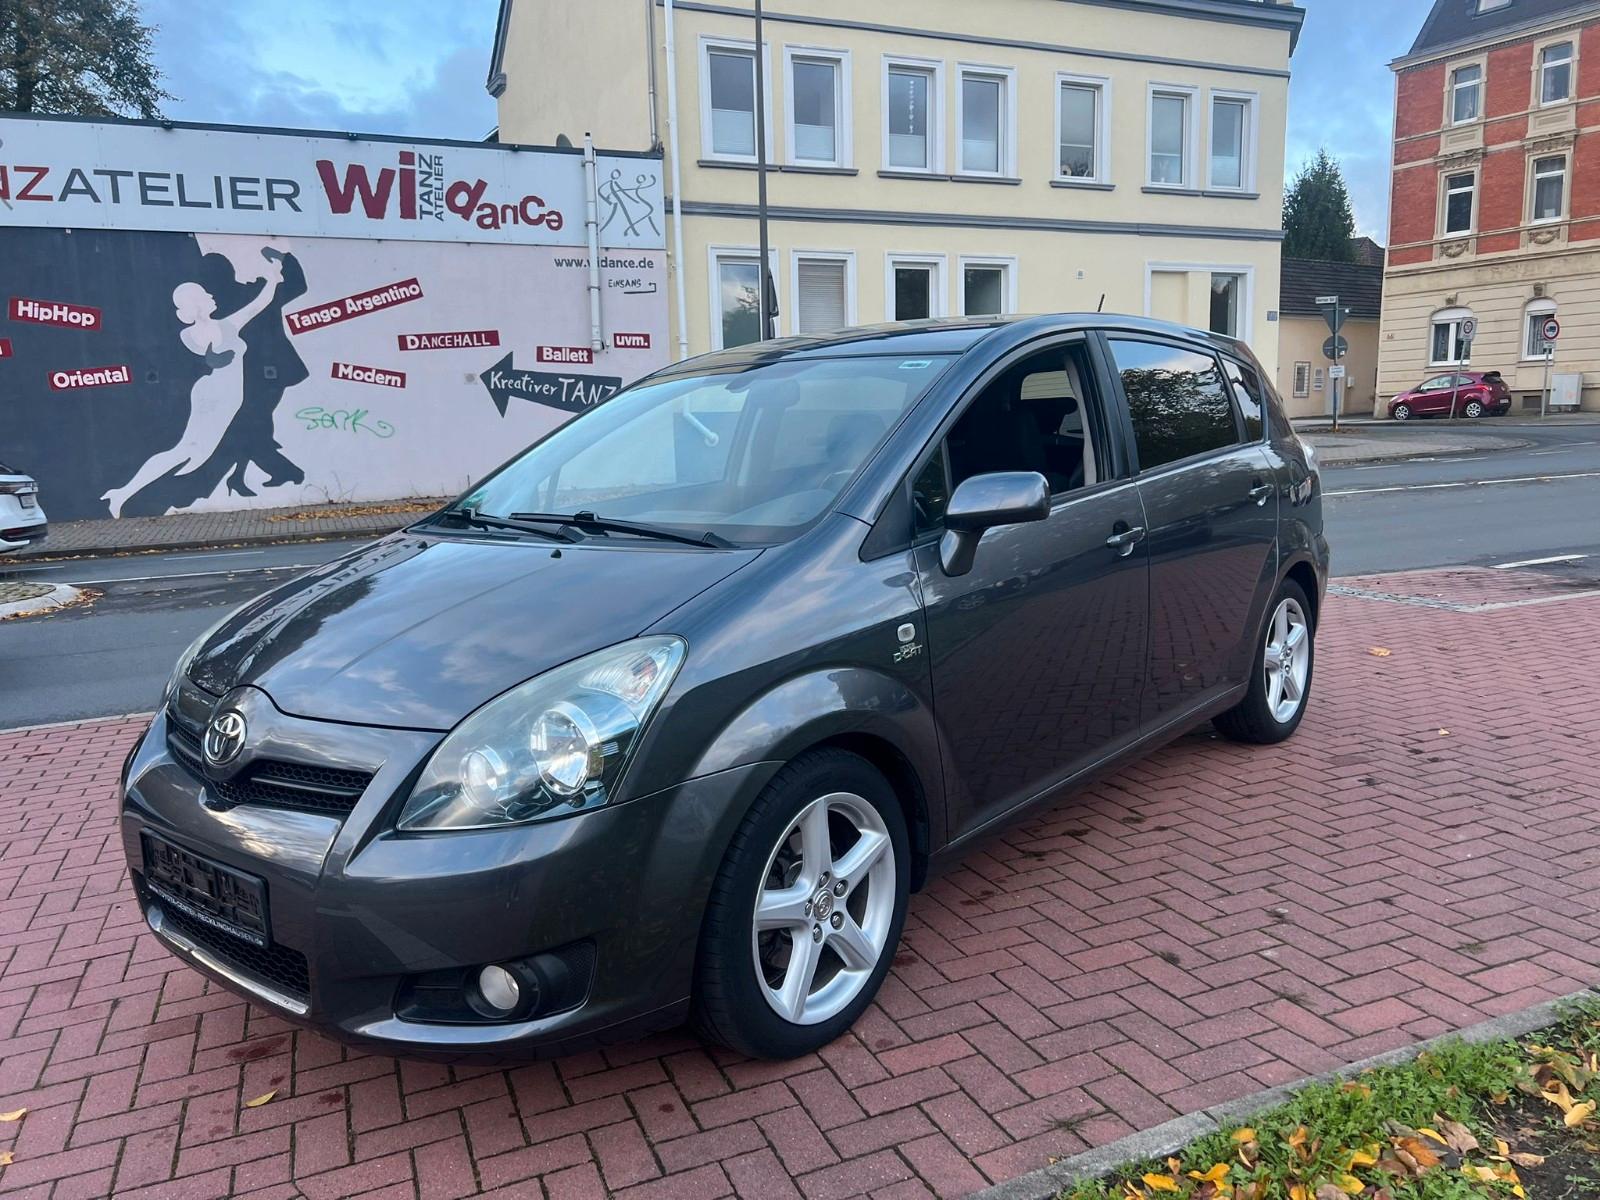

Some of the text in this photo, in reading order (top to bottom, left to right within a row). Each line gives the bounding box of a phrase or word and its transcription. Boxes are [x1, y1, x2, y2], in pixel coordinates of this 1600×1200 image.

[0, 165, 303, 213] ZATELIER
[418, 152, 434, 220] TANZ
[433, 155, 444, 222] ATELIER
[17, 300, 96, 327] HipHop
[290, 281, 421, 331] Tango Argentino
[406, 331, 491, 350] DANCEHALL
[615, 335, 649, 347] uvm.
[542, 347, 589, 363] Ballett
[53, 366, 129, 388] Oriental
[337, 364, 402, 387] Modern
[490, 371, 559, 395] Kreativer
